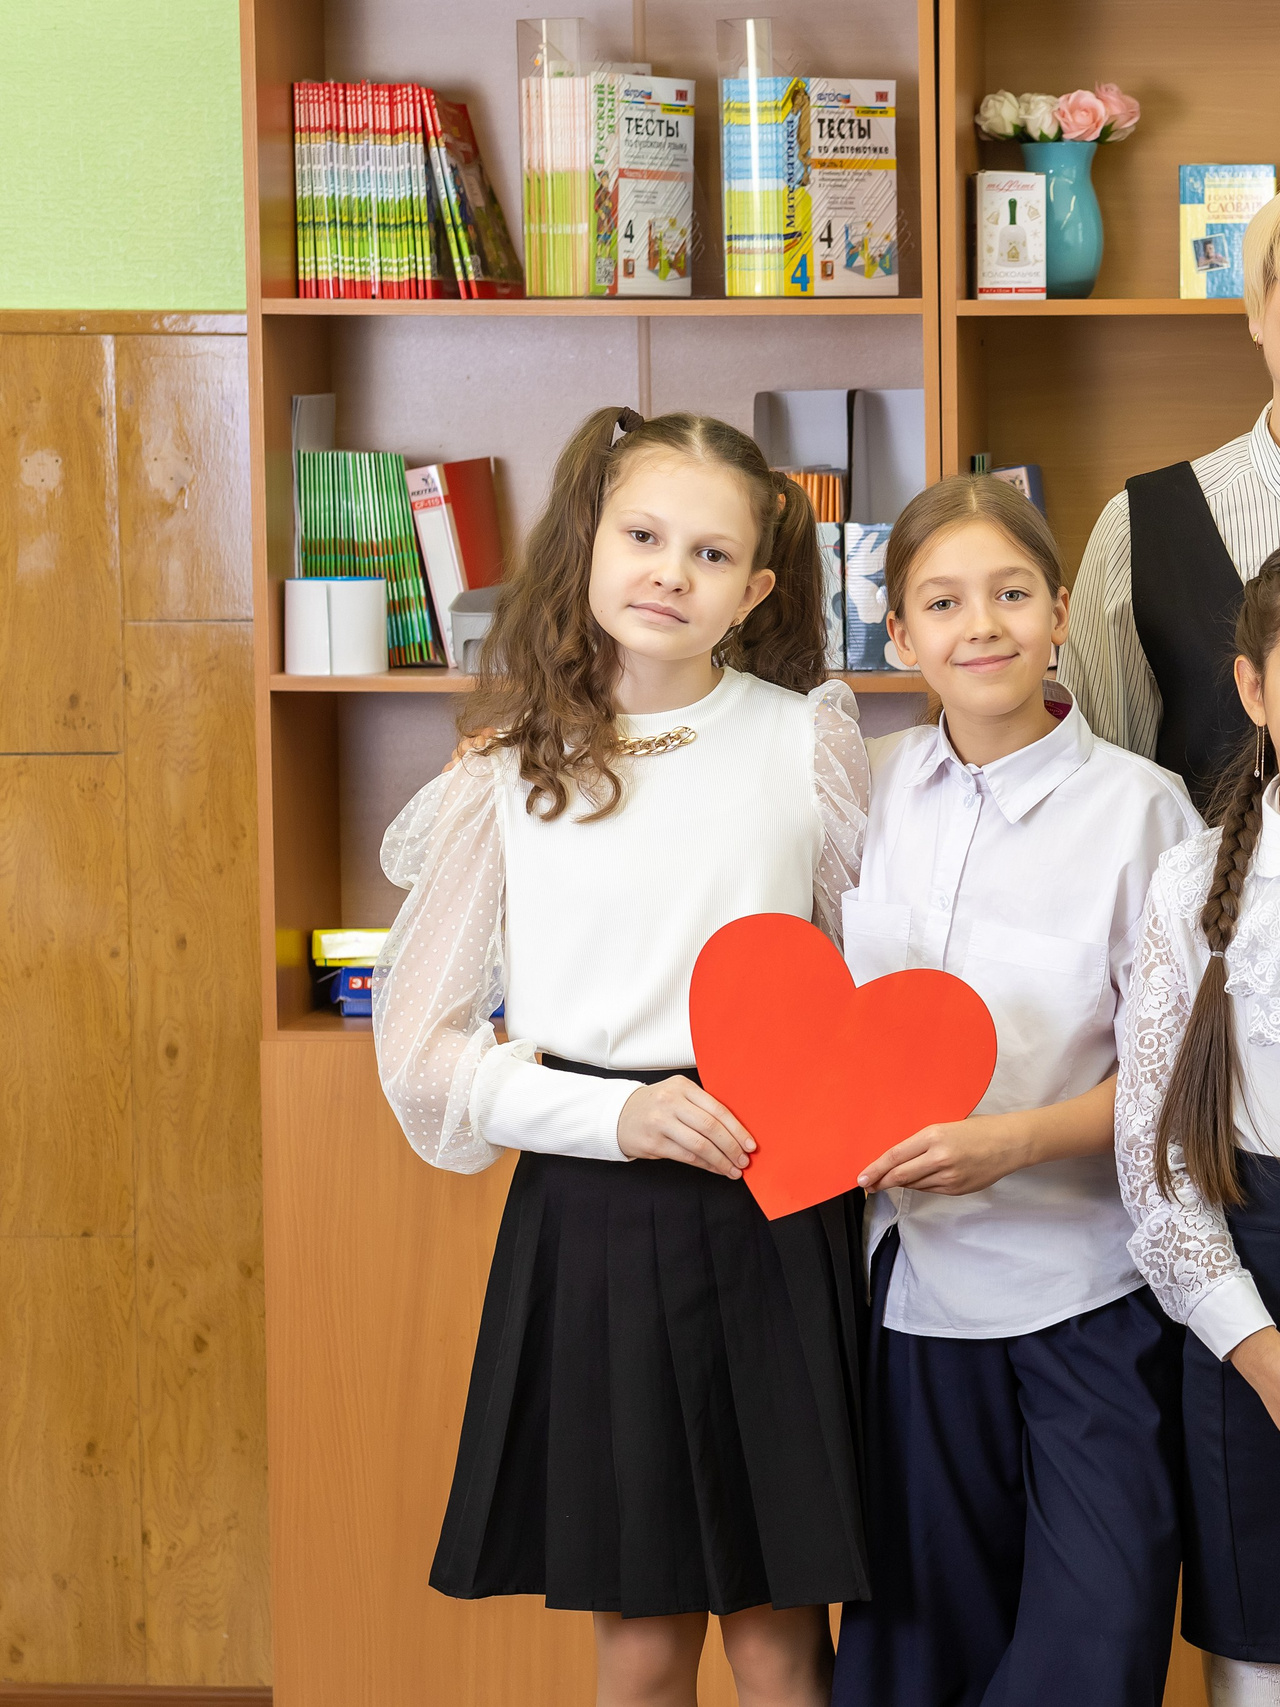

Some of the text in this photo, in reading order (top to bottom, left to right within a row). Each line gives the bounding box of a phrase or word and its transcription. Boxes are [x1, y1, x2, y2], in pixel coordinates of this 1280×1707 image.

[625, 117, 679, 138] ТЕСТЫ
[817, 119, 871, 139] ТЕСТЫ
[786, 119, 796, 229] Математика
[624, 219, 634, 243] 4
[819, 219, 833, 249] 4
[791, 253, 810, 292] 4
